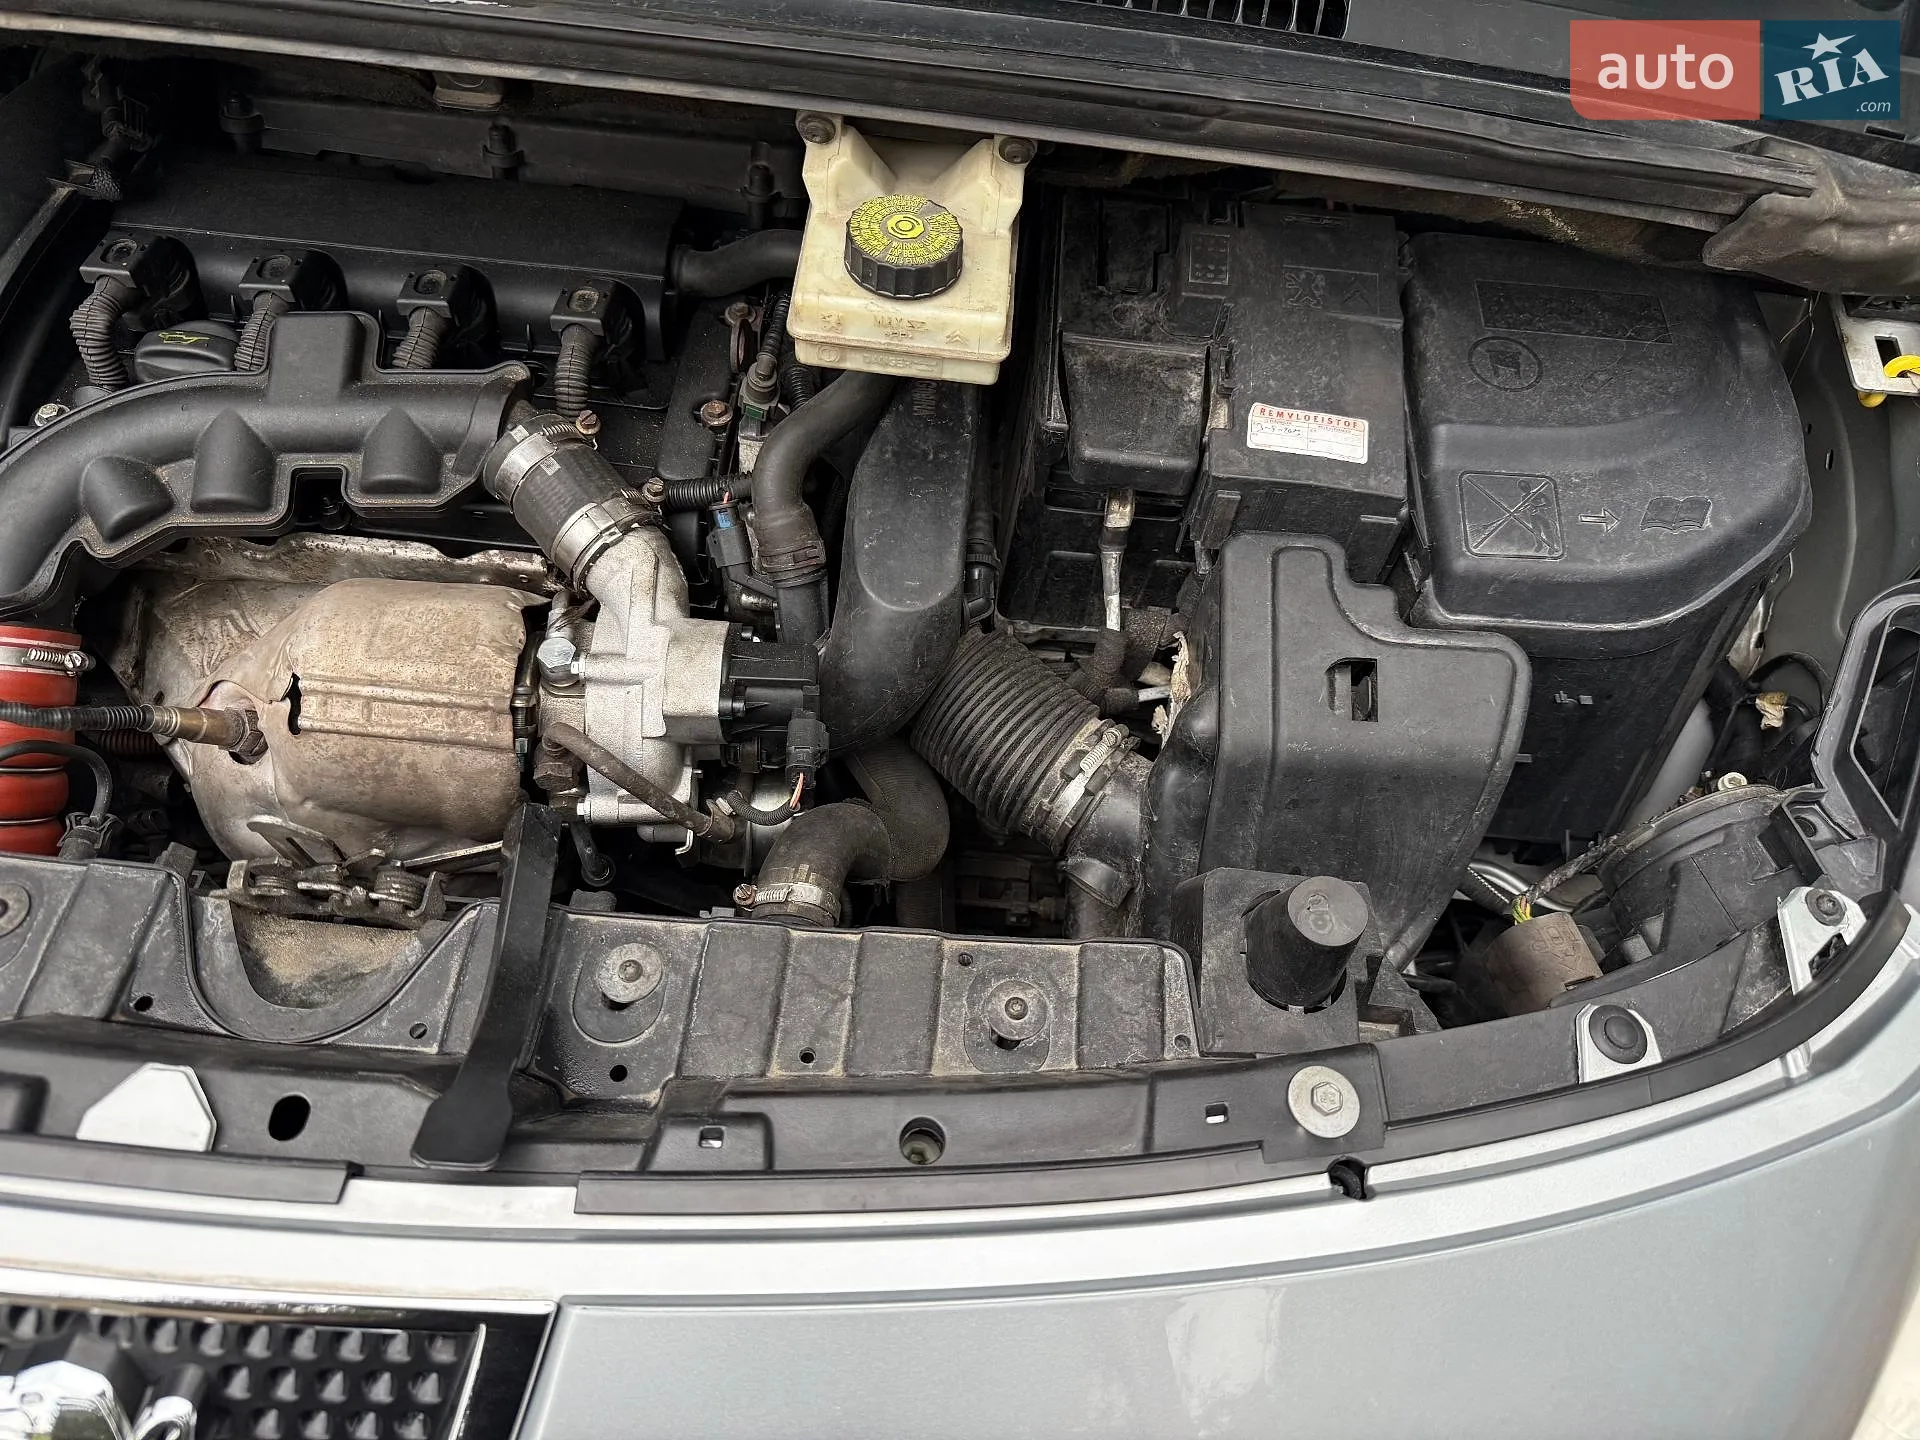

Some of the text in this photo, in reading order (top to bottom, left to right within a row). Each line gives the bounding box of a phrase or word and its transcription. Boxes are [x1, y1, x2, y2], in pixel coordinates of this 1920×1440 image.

[891, 241, 924, 250] WARNING
[888, 248, 929, 257] CAP BEFORE
[1259, 407, 1360, 429] REMVLOEISTOF
